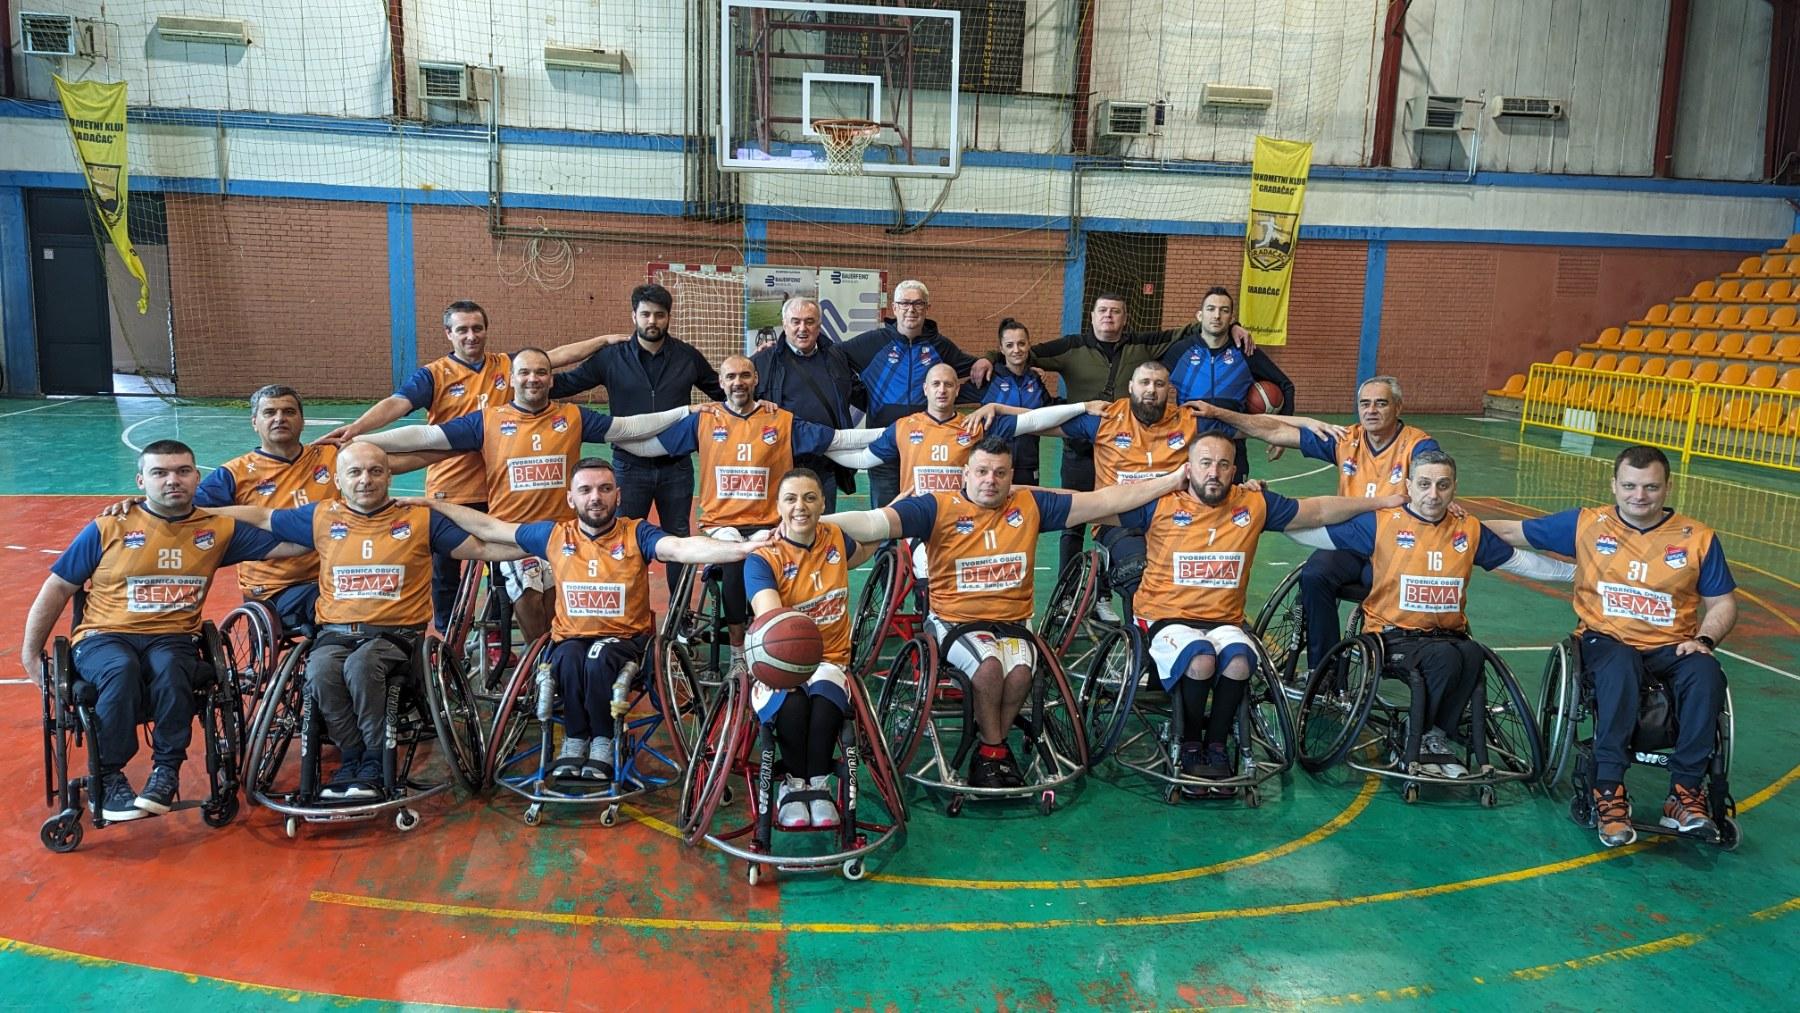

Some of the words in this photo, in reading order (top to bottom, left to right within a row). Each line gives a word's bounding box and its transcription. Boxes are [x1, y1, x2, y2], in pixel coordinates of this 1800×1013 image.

[1289, 176, 1306, 185] KLUB
[532, 434, 542, 451] 2
[737, 443, 752, 461] 21
[931, 444, 949, 461] 20
[1145, 452, 1153, 467] 1
[514, 465, 561, 482] BEMA
[919, 475, 961, 489] BEMA
[721, 475, 764, 490] BEMA
[984, 529, 998, 550] 11
[1207, 528, 1217, 546] 7
[362, 540, 373, 560] 6
[158, 549, 182, 569] 25
[1427, 551, 1443, 571] 16
[588, 559, 598, 577] 5
[963, 564, 1019, 582] BEMA
[1180, 562, 1236, 578] BEMA
[1628, 560, 1648, 583] 31
[339, 575, 395, 592] BEMA
[135, 586, 197, 602] BEMA
[568, 591, 618, 608] BEMA
[1407, 585, 1457, 603] BEMA
[1606, 592, 1670, 617] BEMA
